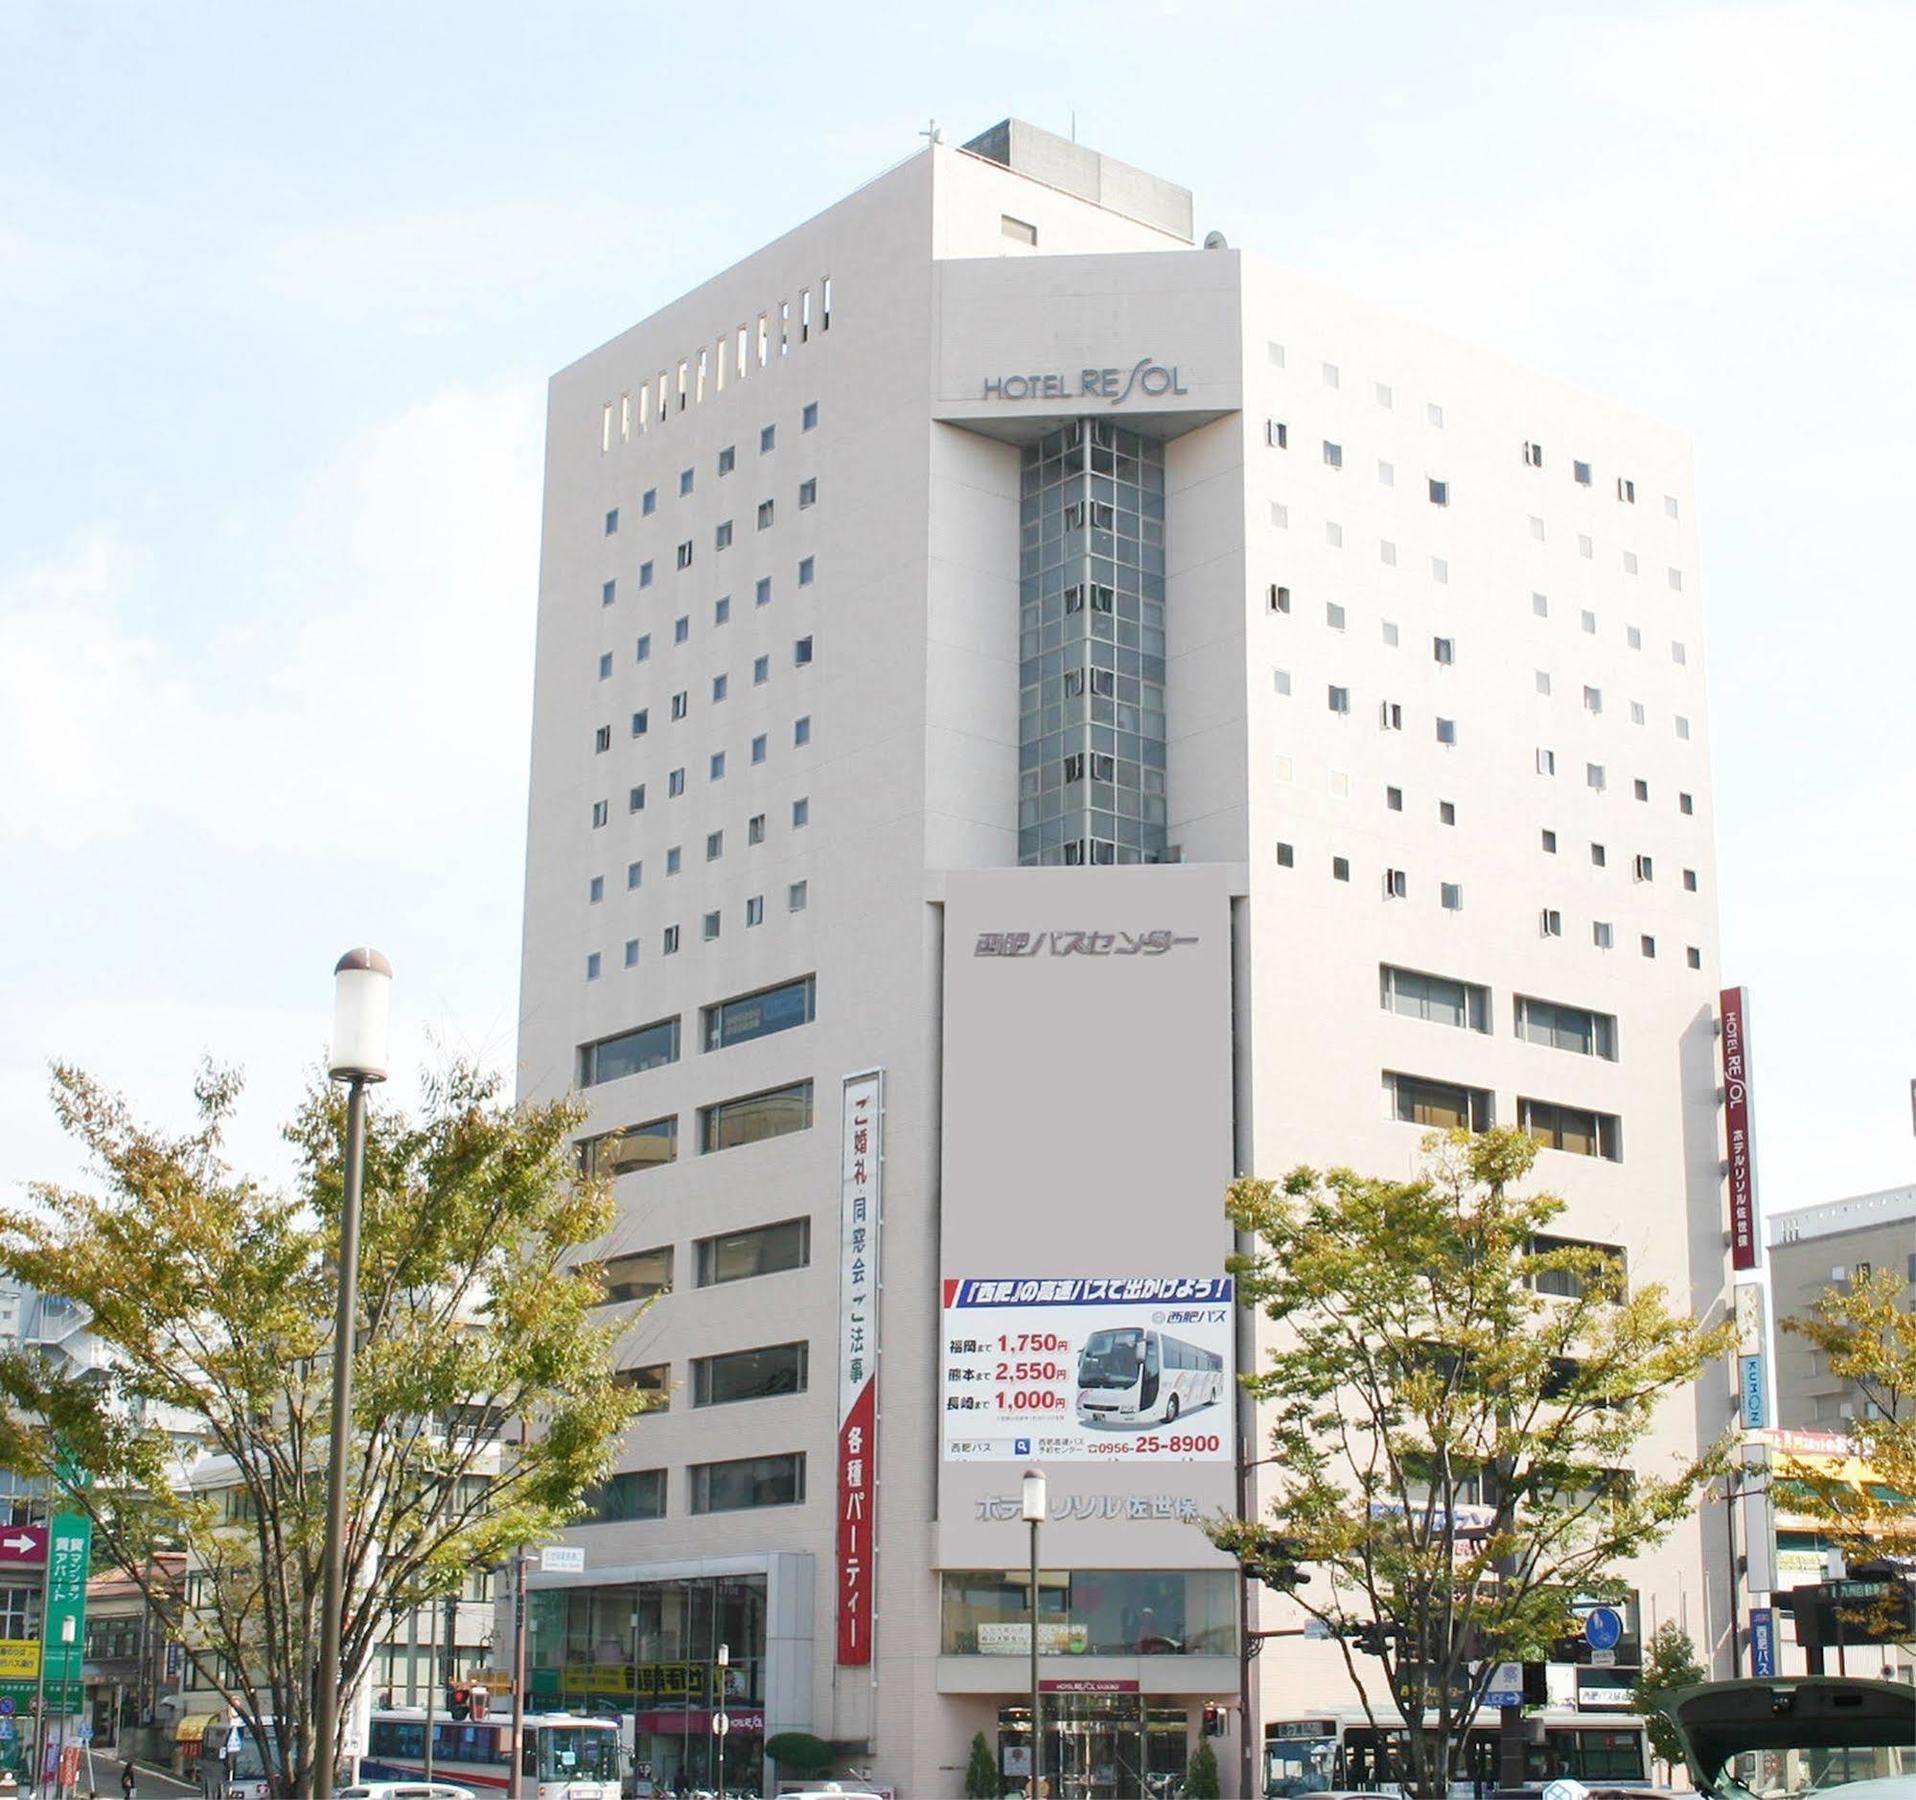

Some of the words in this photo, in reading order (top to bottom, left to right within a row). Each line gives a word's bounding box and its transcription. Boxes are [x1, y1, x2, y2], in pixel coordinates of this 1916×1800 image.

[984, 374, 1072, 400] HOTEL
[1081, 357, 1188, 405] RESOL
[973, 930, 1199, 958] 西肥バスセンター
[1725, 1012, 1740, 1055] HOTEL
[1167, 1310, 1227, 1324] 西肥バス
[950, 1339, 993, 1354] 福岡まで
[1748, 1360, 1760, 1423] KUMON
[951, 1443, 992, 1454] 西肥バス
[1099, 1435, 1220, 1454] 0956-25-8900
[975, 1495, 1201, 1520] ホテリソル佐世保
[846, 1426, 865, 1648] 各種パーティー
